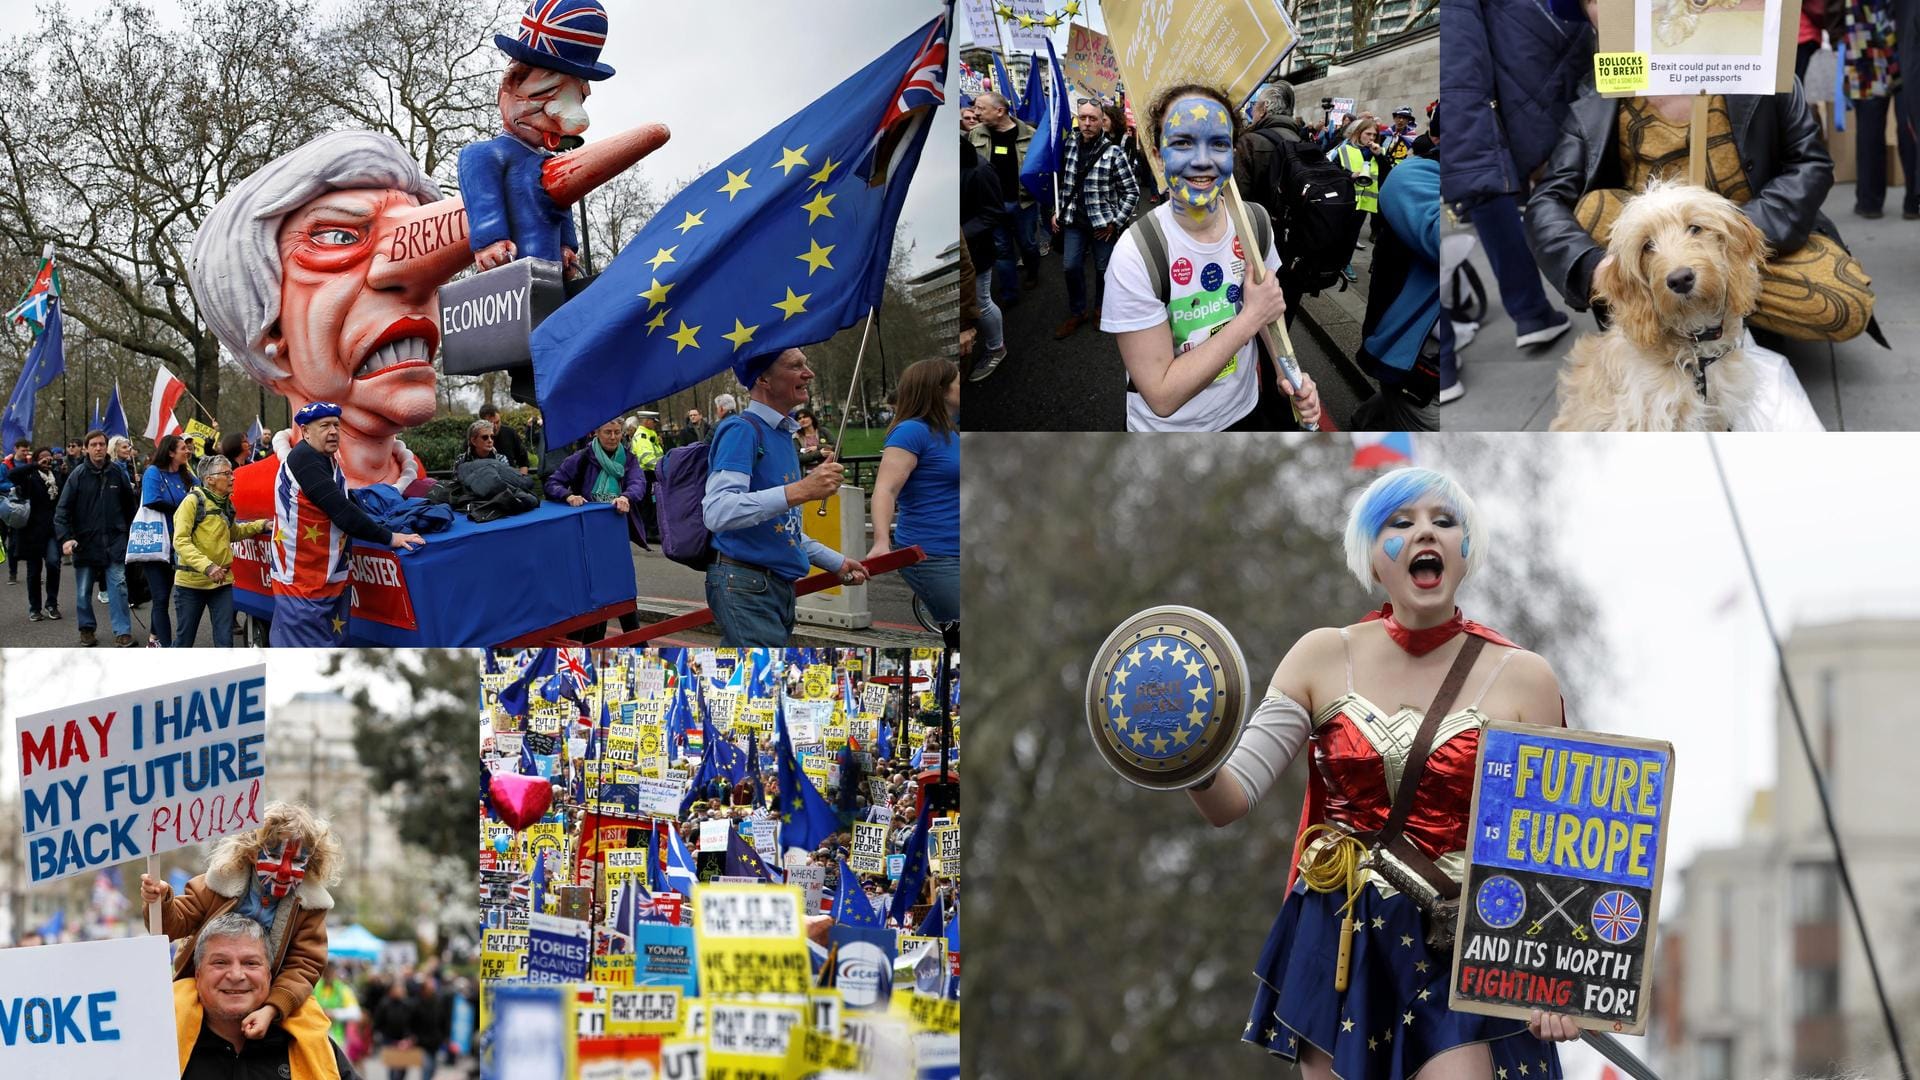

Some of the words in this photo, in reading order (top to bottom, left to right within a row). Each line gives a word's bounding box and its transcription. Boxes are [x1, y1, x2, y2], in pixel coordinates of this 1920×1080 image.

[1599, 57, 1642, 66] BOLLOCKS
[1706, 63, 1719, 73] put
[1599, 68, 1610, 76] TO
[1613, 66, 1643, 75] BREXIT
[1684, 74, 1698, 84] pet
[1700, 74, 1742, 84] passports
[388, 208, 468, 262] BREXIT
[443, 286, 526, 335] ECONOMY
[1173, 297, 1230, 324] People's
[20, 712, 117, 776] MAY
[132, 704, 144, 750] I
[155, 676, 266, 744] HAVE
[608, 749, 632, 760] VOTE
[1487, 761, 1512, 778] THE
[23, 774, 89, 832] MY
[104, 734, 265, 812] FUTURE
[1515, 744, 1660, 816] FUTURE
[587, 788, 598, 799] VO
[856, 826, 873, 835] PUT
[875, 828, 883, 836] IT
[943, 830, 959, 840] PUT
[1485, 826, 1499, 840] IS
[856, 835, 864, 843] TO
[868, 837, 882, 845] THE
[1507, 808, 1652, 877] EUROPE
[29, 814, 141, 882] BACK
[854, 842, 881, 853] PEOPLE
[791, 869, 818, 880] WHERE
[488, 935, 504, 944] PUT
[508, 935, 515, 944] IT
[520, 936, 529, 945] TO
[903, 941, 919, 949] PUT
[532, 938, 584, 960] TORIES
[648, 947, 684, 955] YOUNG
[1464, 935, 1509, 962] AND
[1515, 940, 1548, 968] IT'S
[1556, 945, 1632, 980] WORTH
[531, 956, 584, 974] AGAINST
[1461, 966, 1574, 1006] FIGHTING
[1584, 984, 1635, 1016] FOR!
[613, 995, 637, 1007] PUT
[642, 995, 653, 1007] IT
[661, 995, 675, 1008] TO
[614, 1010, 629, 1019] THE
[635, 1010, 672, 1019] PEOPLE
[664, 1050, 699, 1080] UT
